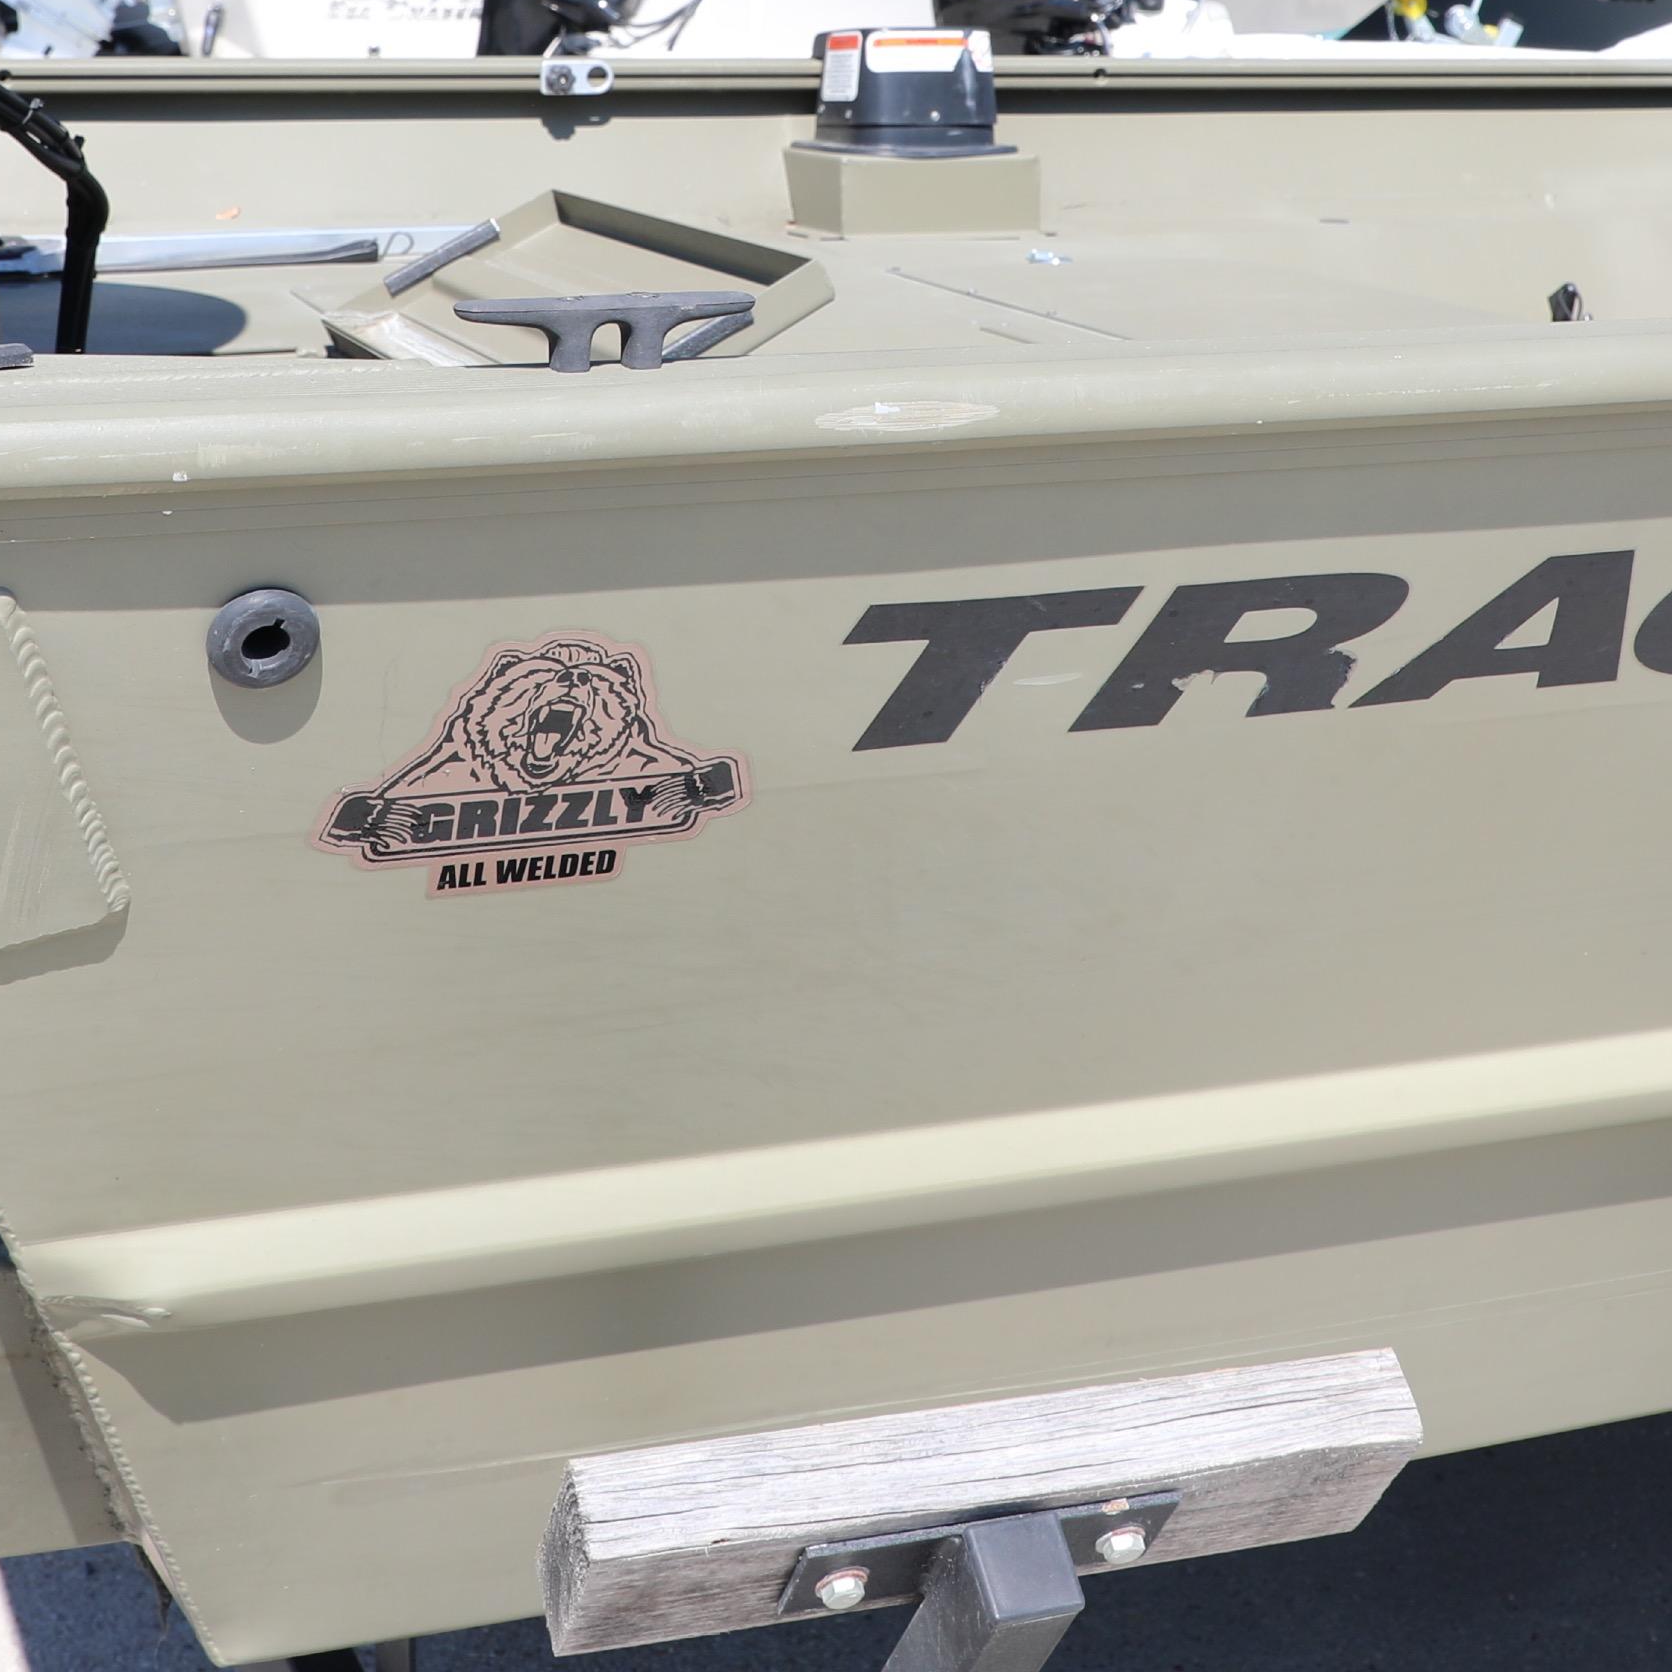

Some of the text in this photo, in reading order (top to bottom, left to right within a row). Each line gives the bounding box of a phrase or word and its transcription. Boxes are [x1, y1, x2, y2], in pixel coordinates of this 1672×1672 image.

[411, 784, 656, 844] GRIZZLY
[436, 849, 617, 890] ALL WELDED
